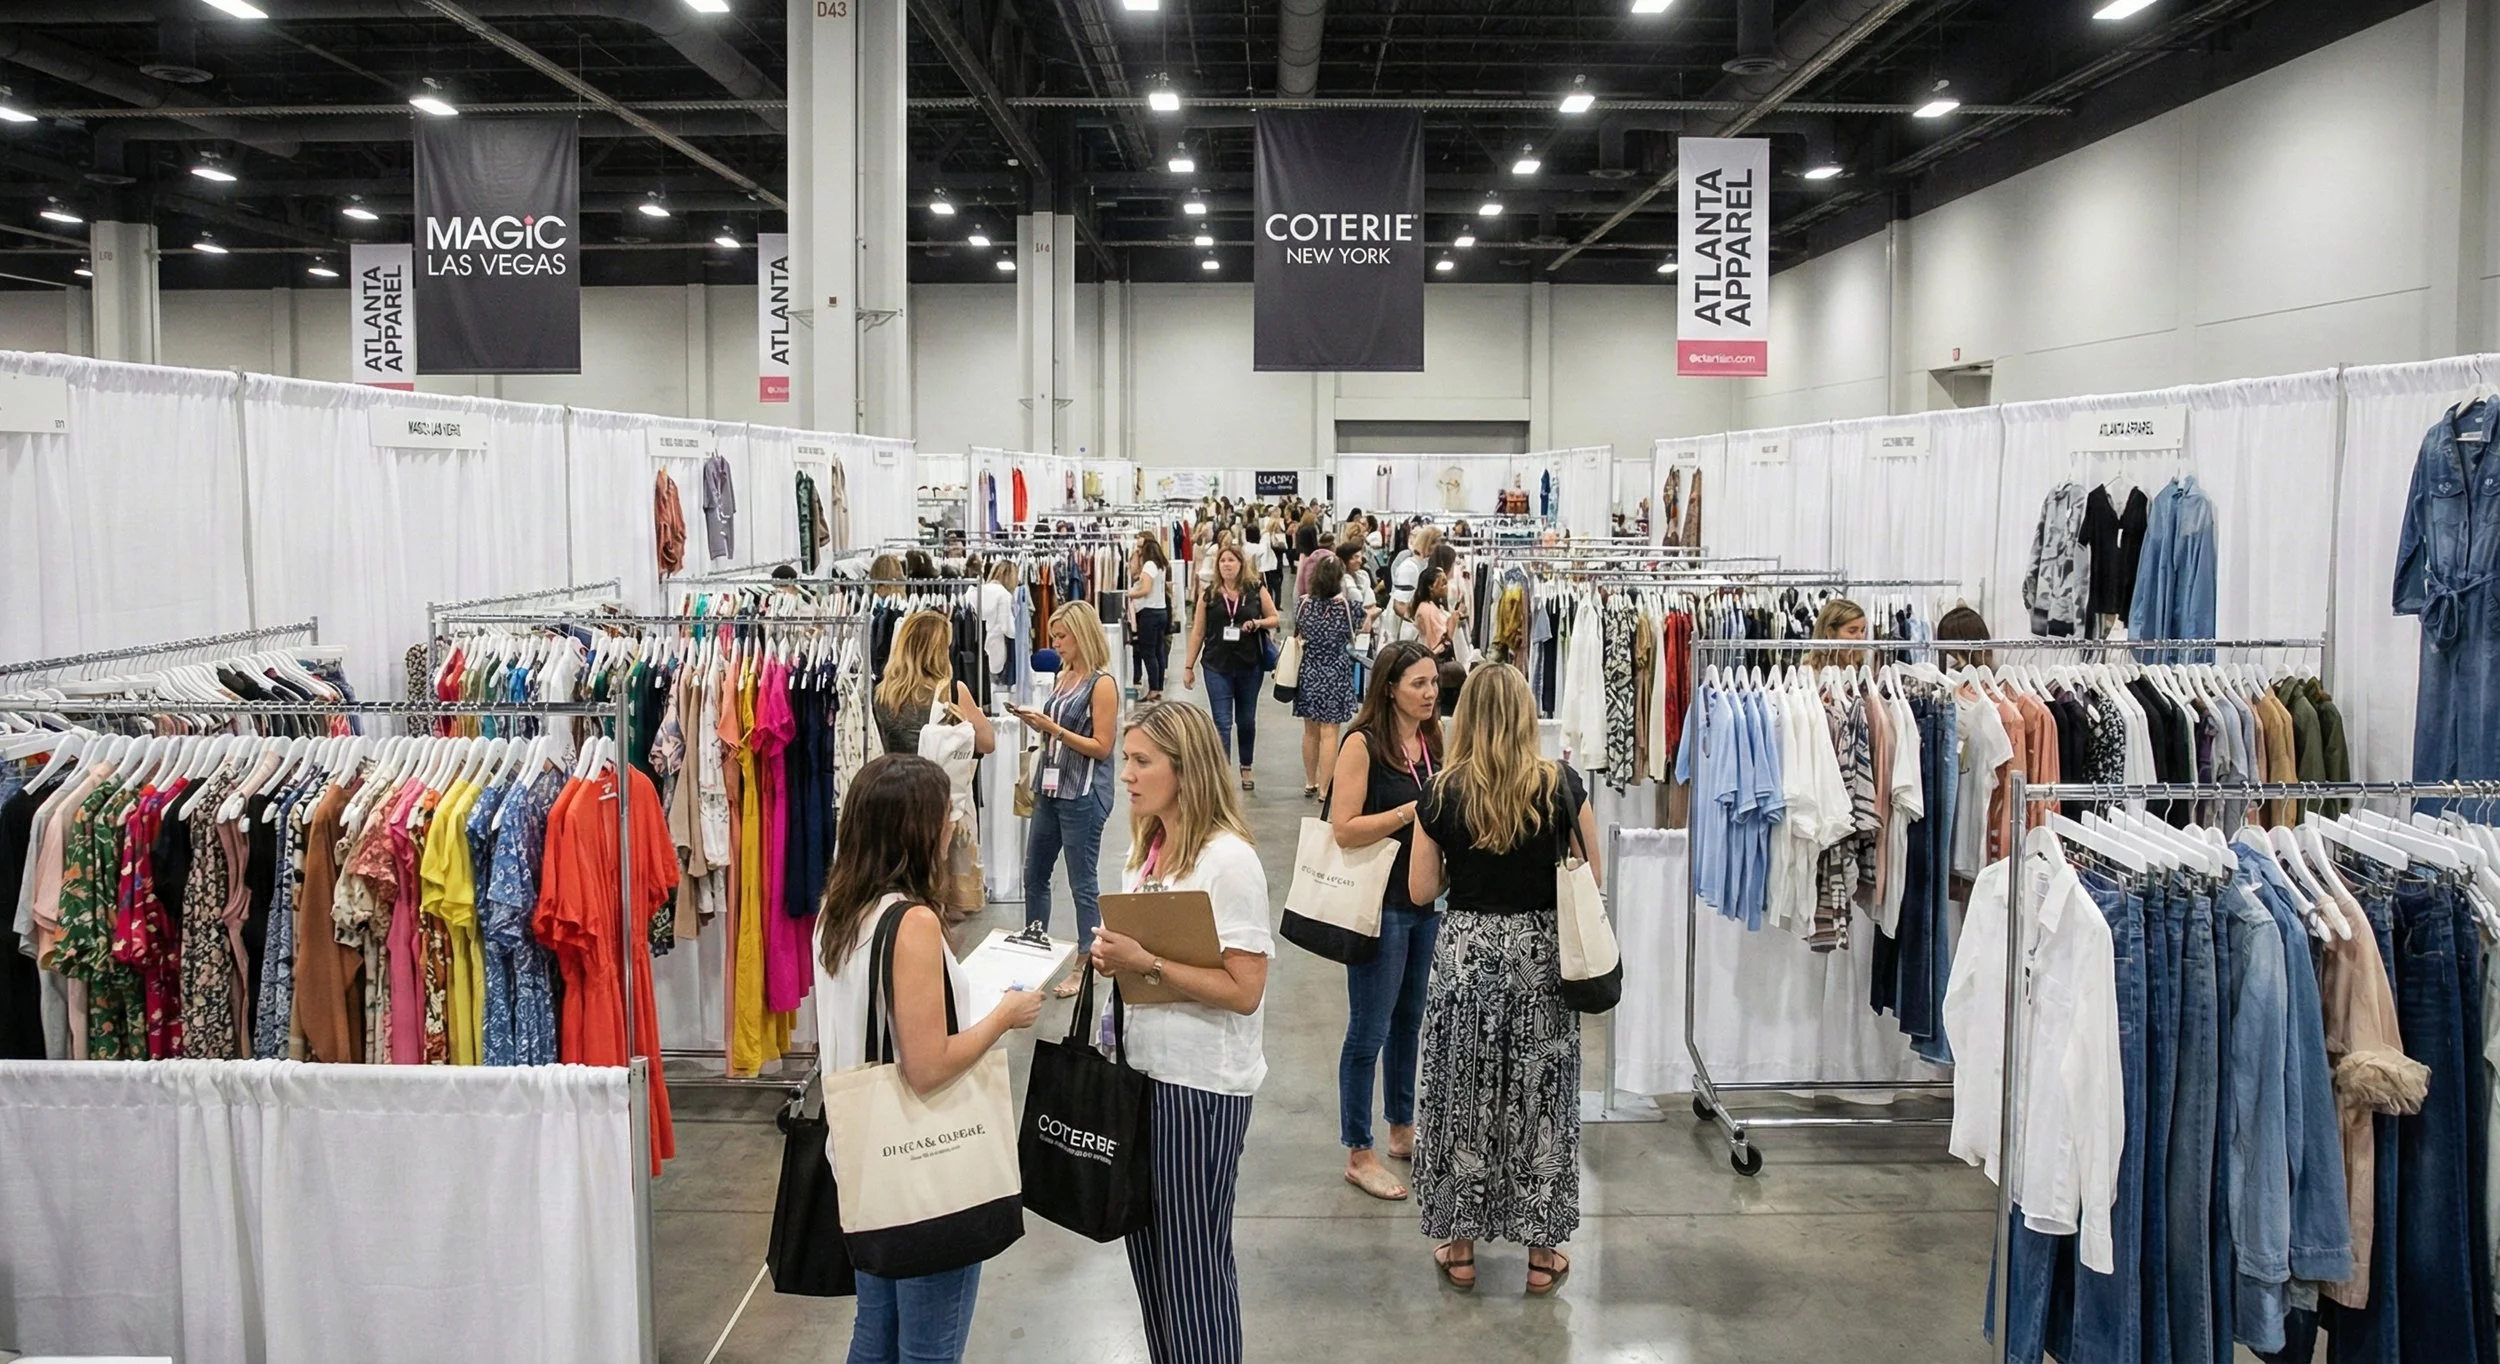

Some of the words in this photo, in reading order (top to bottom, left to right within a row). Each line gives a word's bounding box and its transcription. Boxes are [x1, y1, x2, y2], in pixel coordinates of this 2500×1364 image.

[817, 1, 847, 18] D43
[427, 254, 473, 276] LAS
[480, 253, 566, 276] VEGAS
[1286, 247, 1334, 265] NEW
[1338, 247, 1391, 265] YORK
[1694, 167, 1722, 327] ATLANTA
[1725, 168, 1752, 327] APPAREL
[363, 265, 383, 373] ATLANTA
[383, 264, 403, 373] APPAREL
[770, 255, 790, 366] ATLANTA
